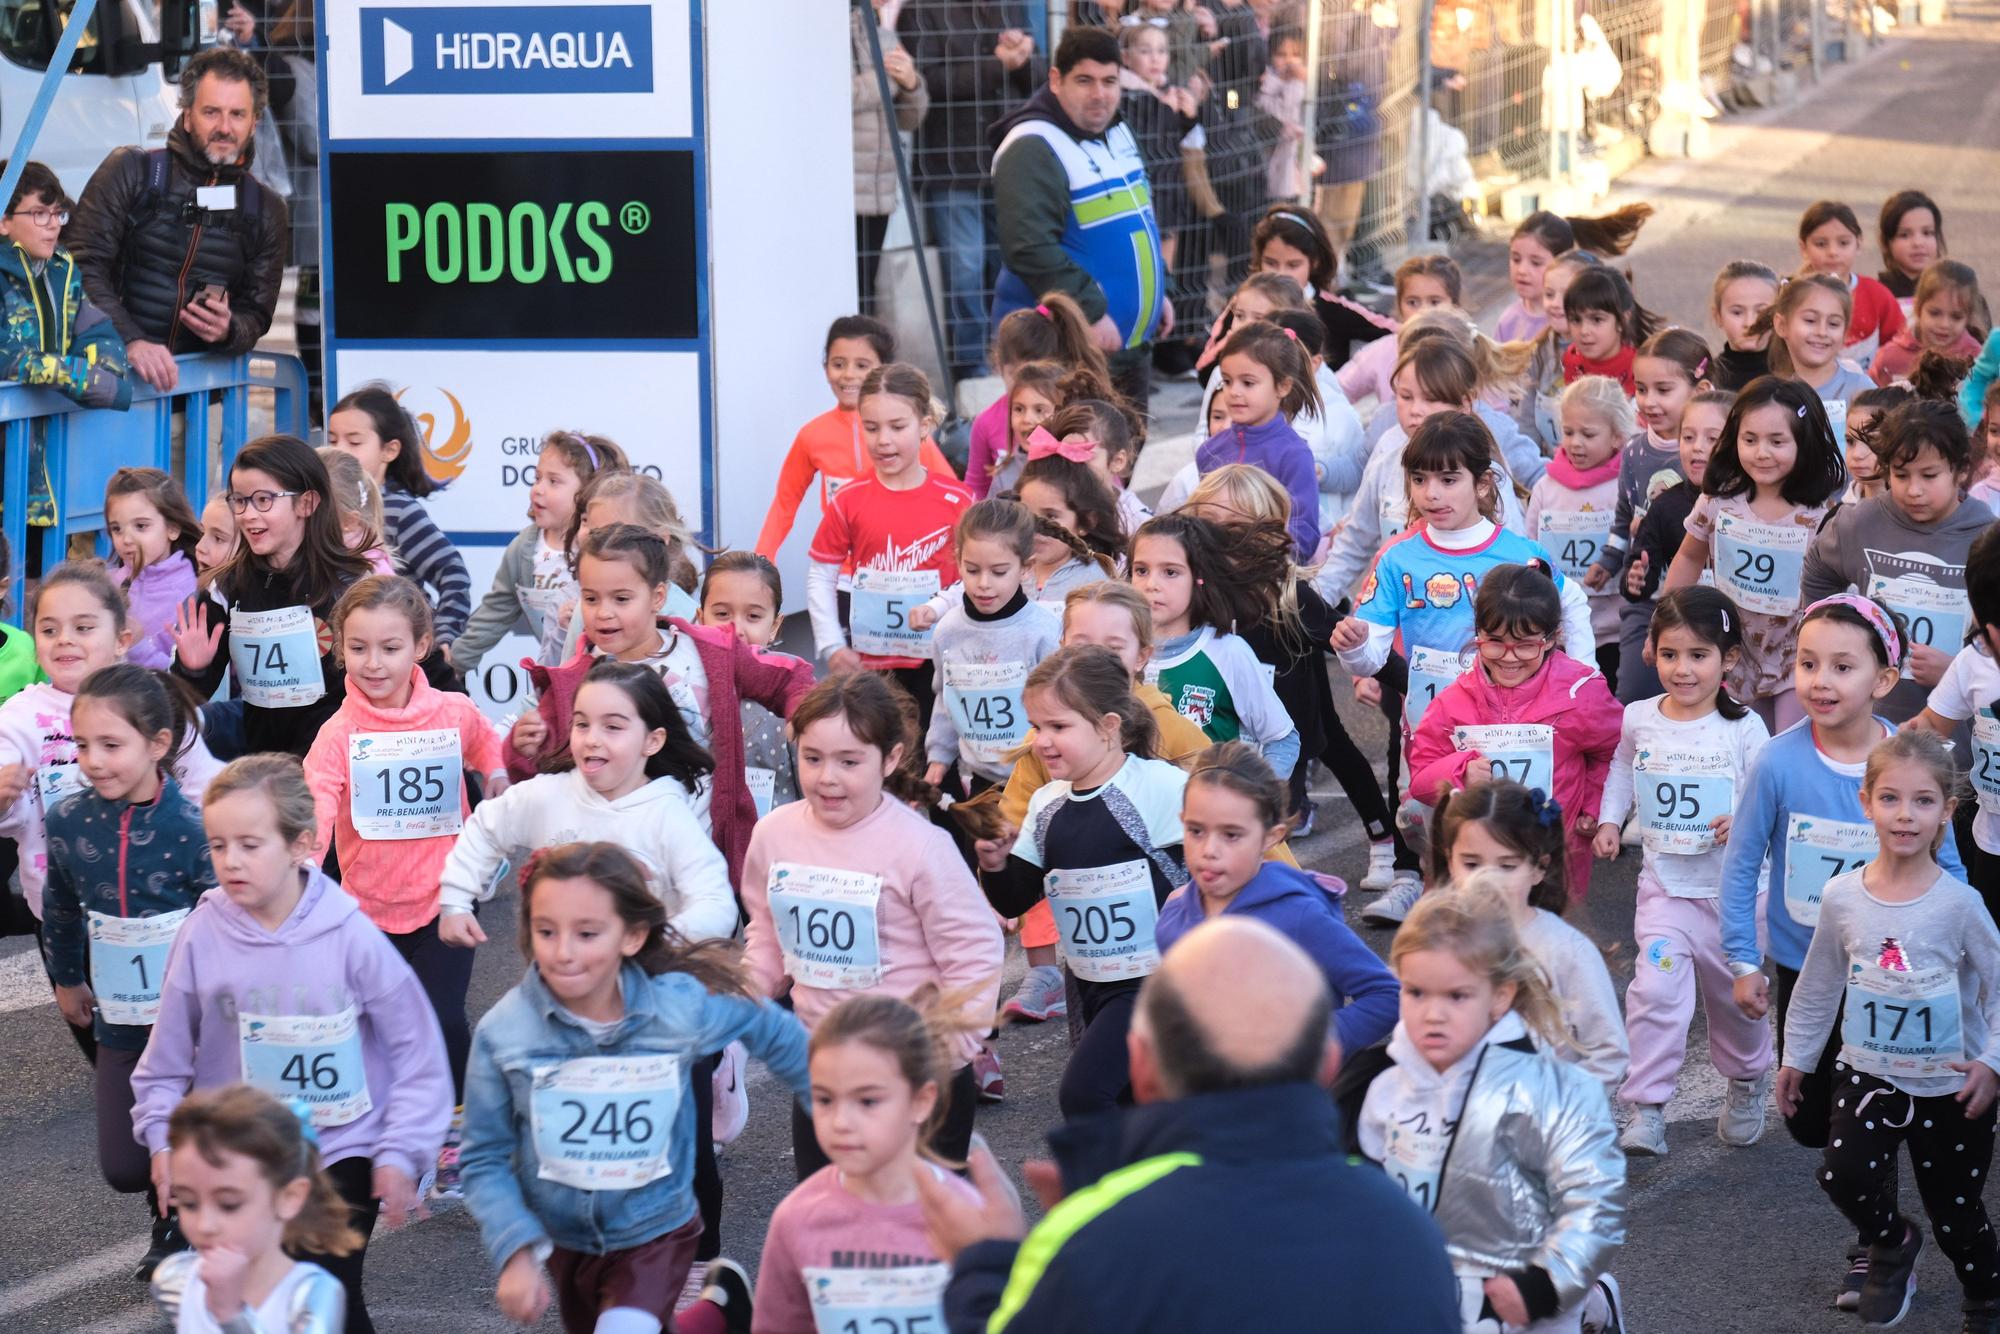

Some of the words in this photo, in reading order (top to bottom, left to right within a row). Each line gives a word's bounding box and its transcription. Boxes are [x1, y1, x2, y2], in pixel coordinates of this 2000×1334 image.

[1561, 539, 1597, 568] 42
[1734, 549, 1775, 584] 29
[886, 600, 904, 629] 5
[243, 643, 288, 675] 74
[960, 696, 1014, 730] 143
[376, 765, 444, 804] 185
[1656, 782, 1701, 819] 95
[789, 905, 855, 951] 160
[1065, 901, 1136, 944] 205
[130, 954, 149, 990] 1
[1863, 1001, 1933, 1042] 171
[280, 1052, 339, 1090] 46
[560, 1100, 654, 1145] 246
